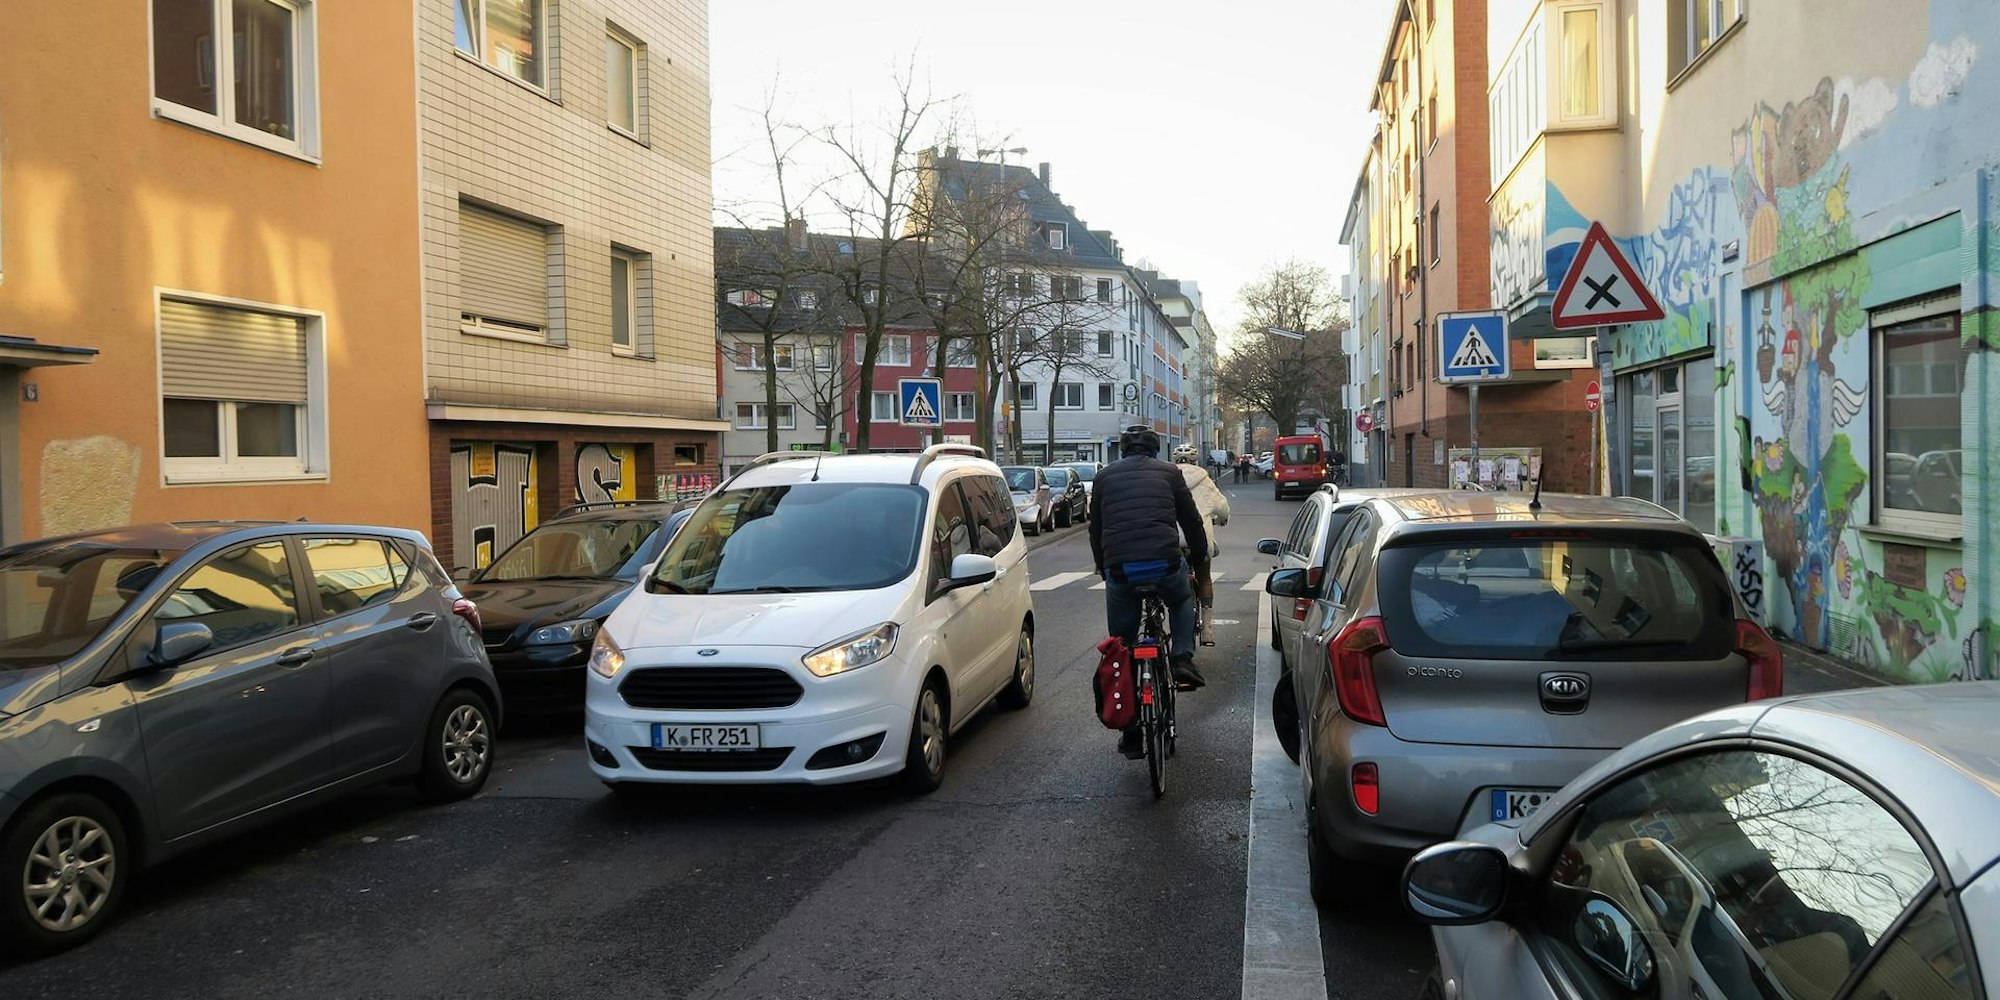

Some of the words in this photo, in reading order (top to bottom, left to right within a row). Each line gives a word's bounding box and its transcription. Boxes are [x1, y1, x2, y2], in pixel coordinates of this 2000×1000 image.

[1407, 665, 1463, 679] picanto
[1551, 680, 1580, 692] KIA
[667, 727, 679, 746] K
[690, 727, 713, 746] FR
[718, 727, 751, 746] 251
[1510, 795, 1525, 818] K
